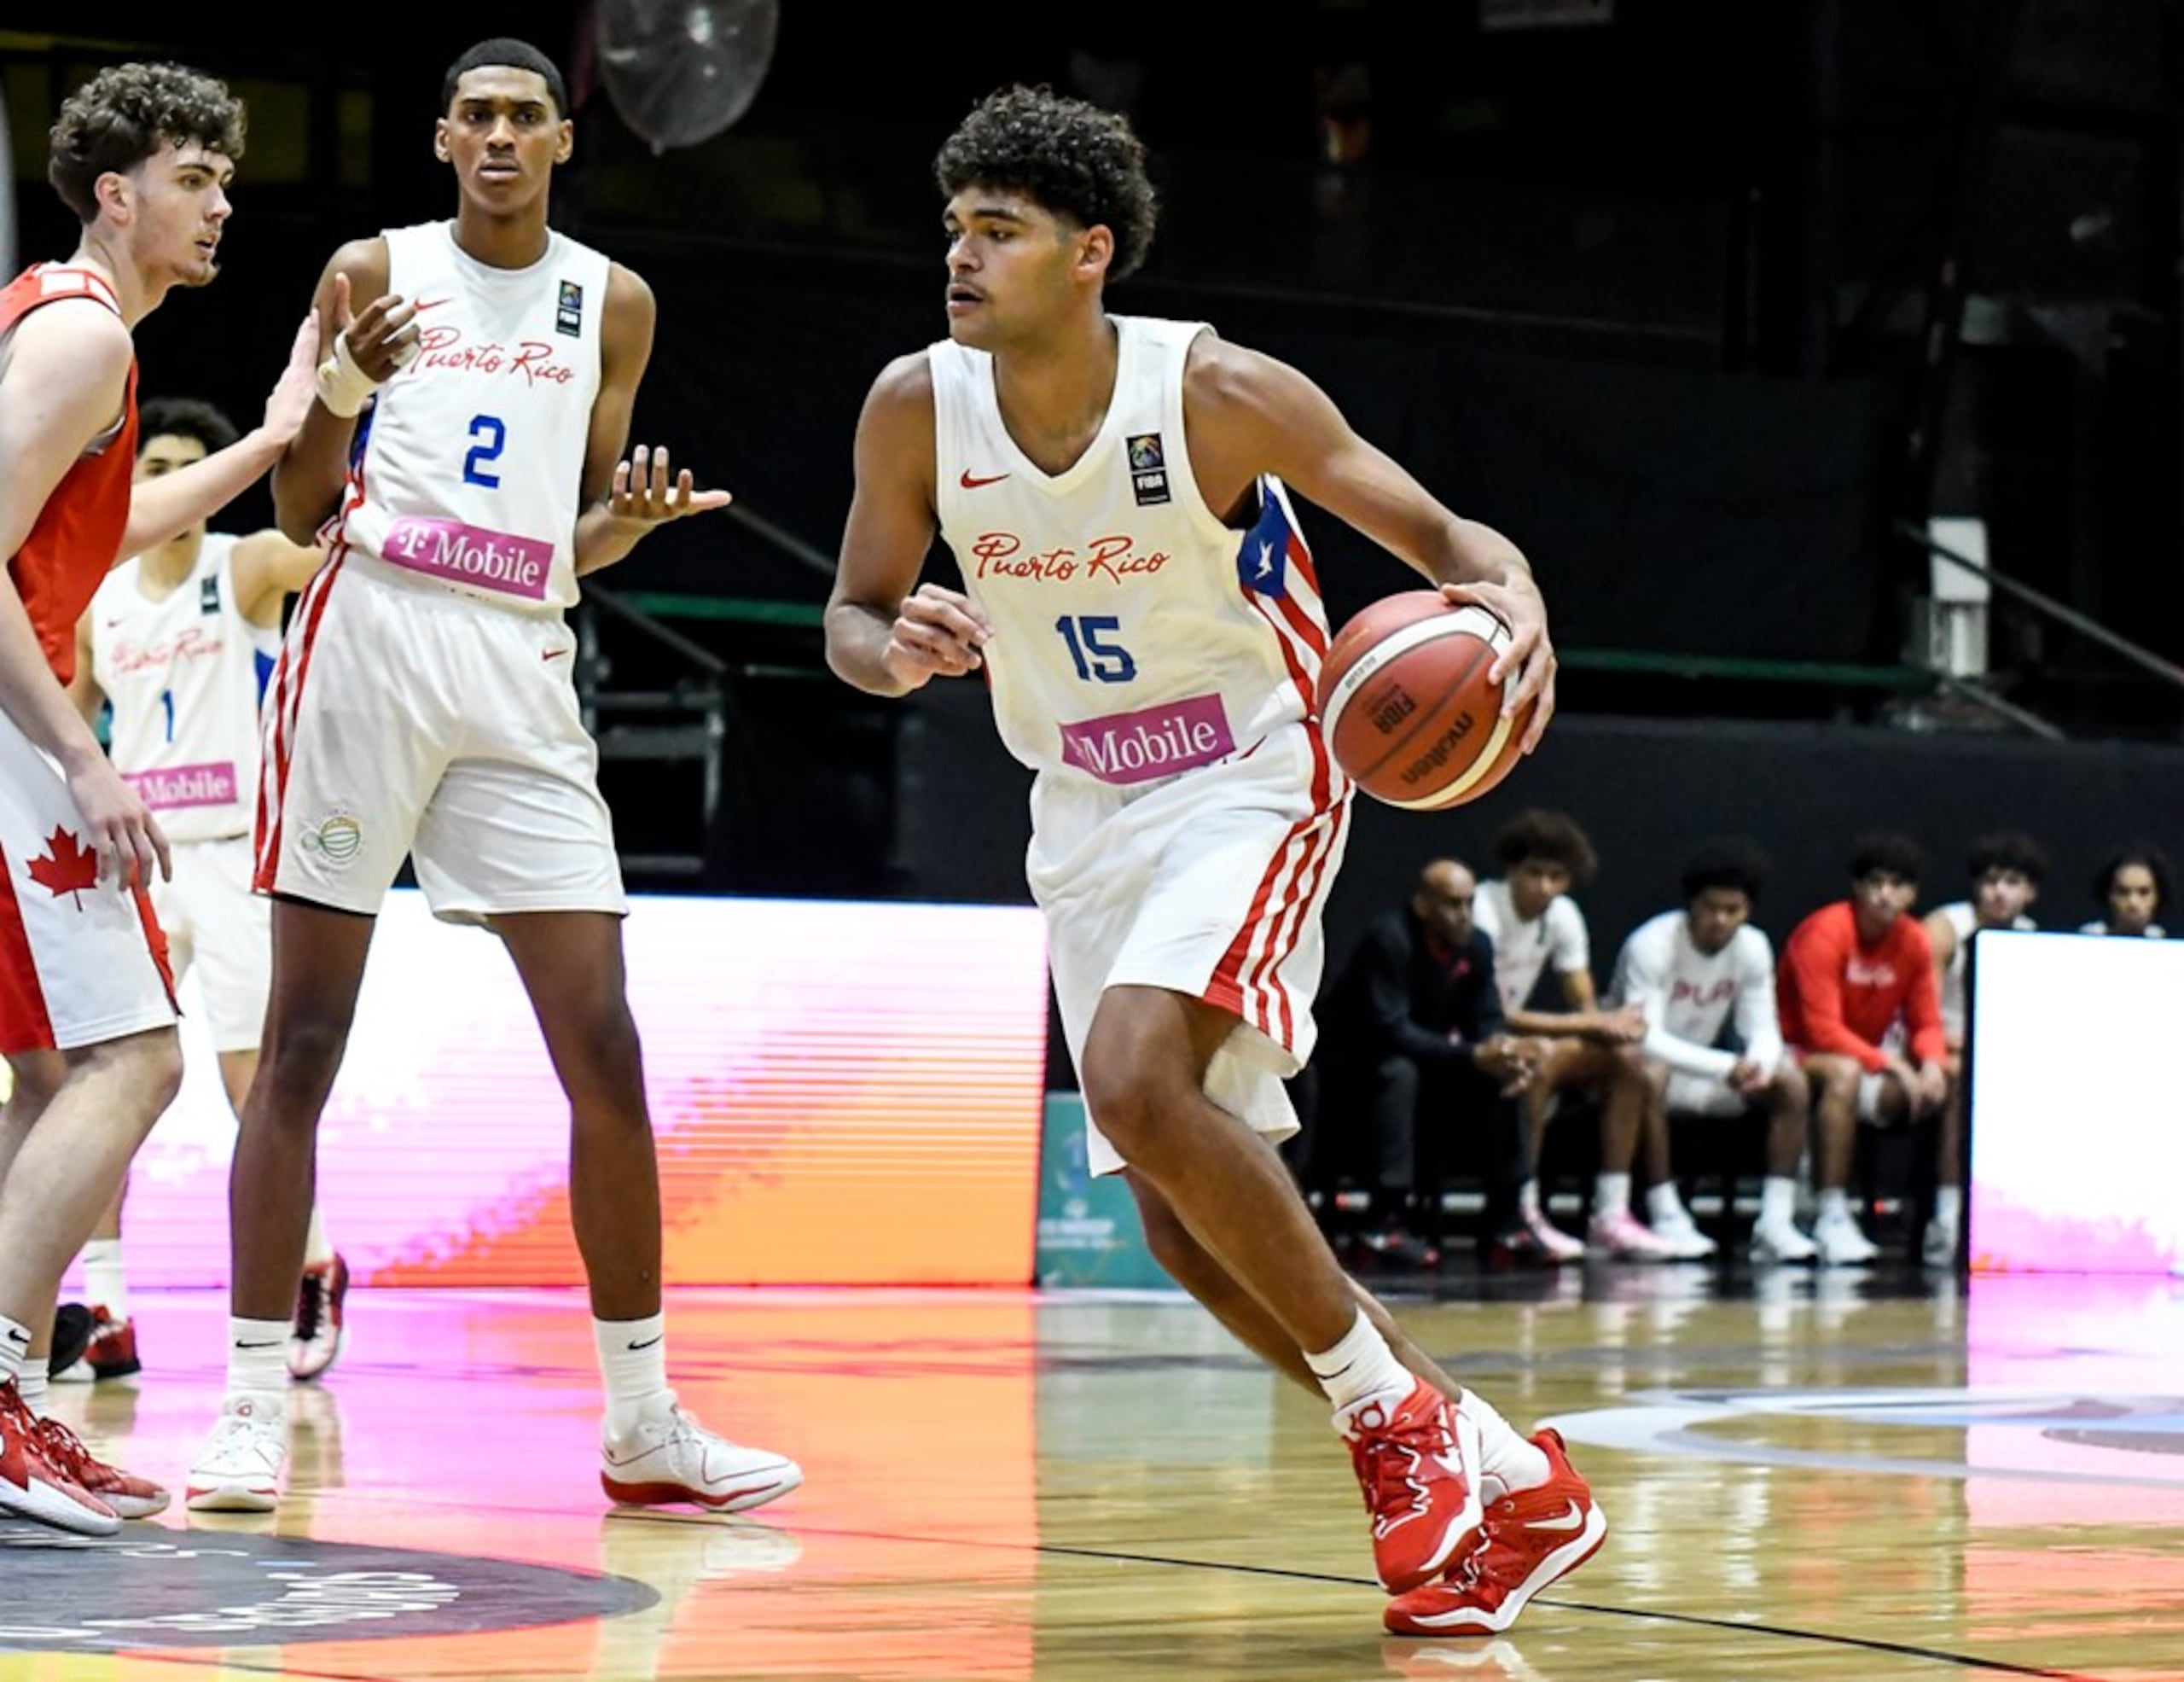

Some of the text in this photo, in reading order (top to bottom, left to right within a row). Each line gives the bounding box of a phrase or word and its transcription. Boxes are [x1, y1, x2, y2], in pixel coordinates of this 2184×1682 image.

[410, 326, 575, 387] Puerto Rico
[463, 415, 506, 489] 2
[429, 530, 540, 587] Mobile
[972, 533, 1171, 585] Puerto Rico
[1054, 615, 1137, 683] 15
[160, 690, 174, 743] 1
[1081, 715, 1218, 774] Mobile
[1401, 711, 1475, 784] molten
[140, 772, 230, 803] Mobile
